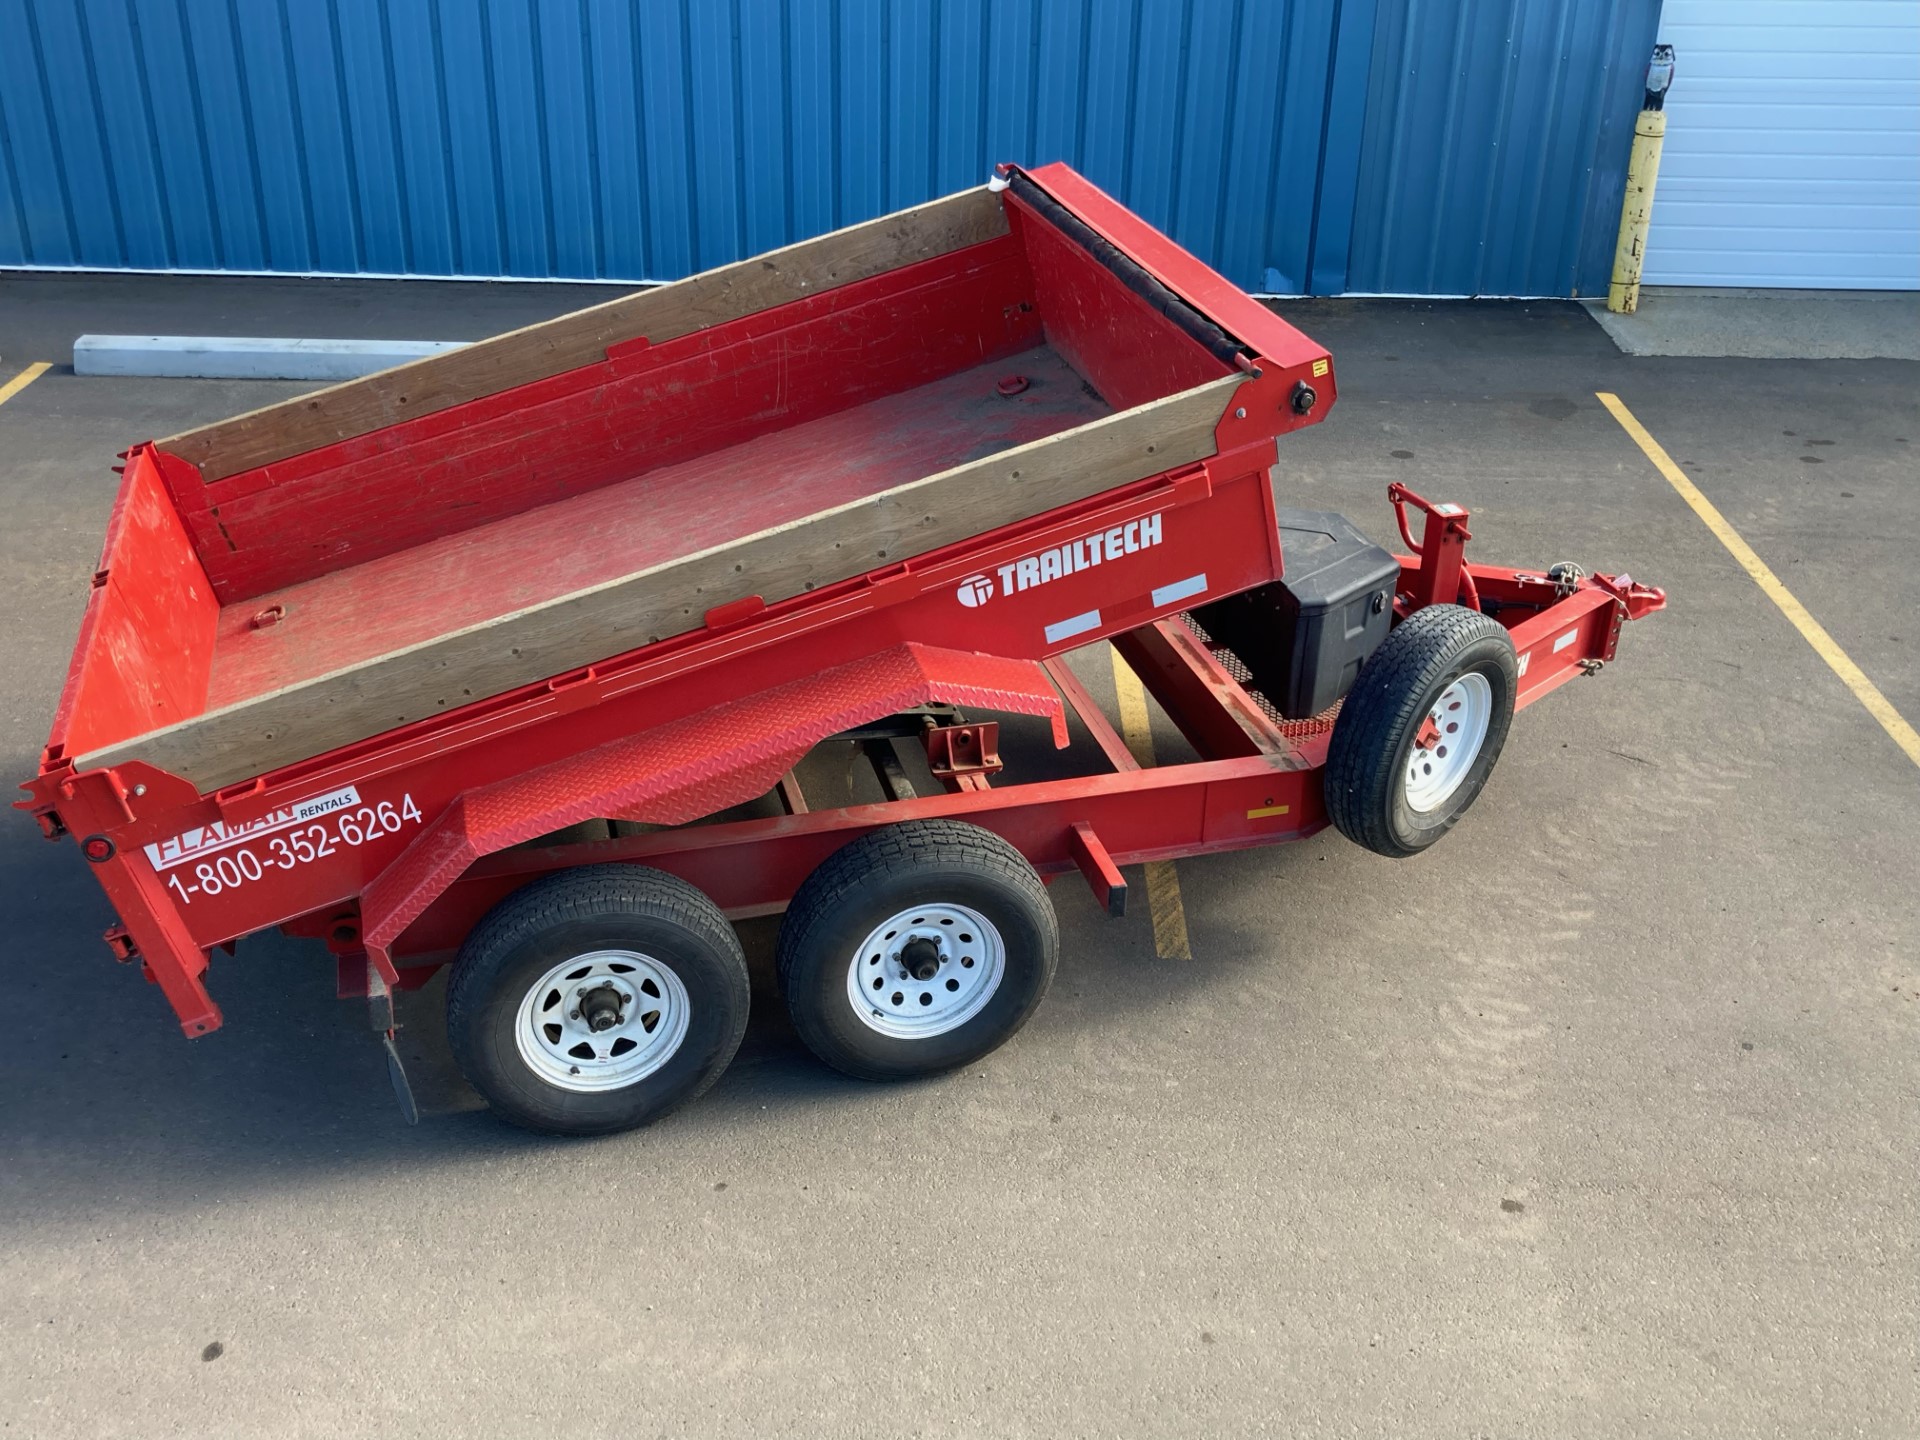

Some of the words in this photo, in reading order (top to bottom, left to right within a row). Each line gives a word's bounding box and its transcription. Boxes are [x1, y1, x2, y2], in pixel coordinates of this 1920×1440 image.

[997, 513, 1163, 597] TRAILTECH
[300, 793, 353, 819] RENTALS
[168, 793, 422, 904] 1-800-352-6264
